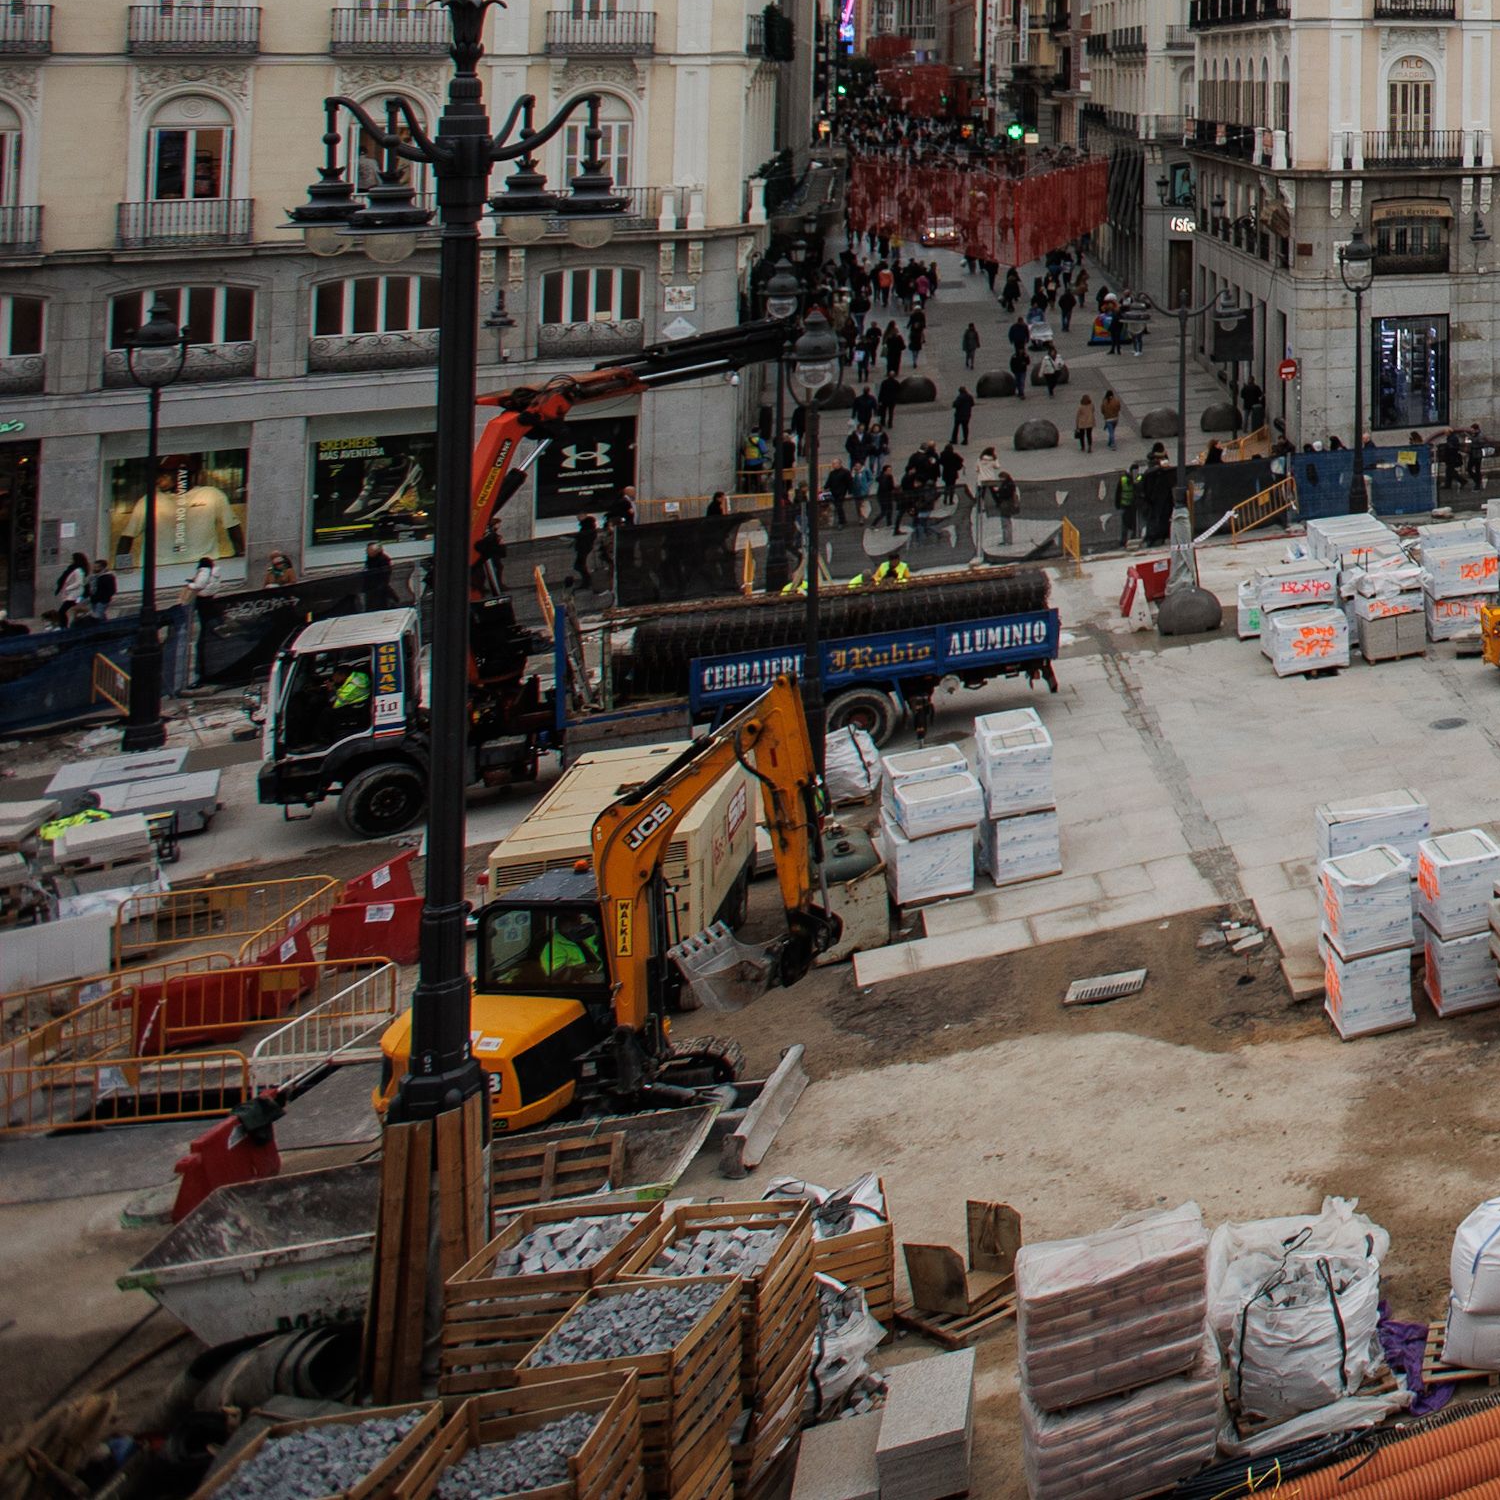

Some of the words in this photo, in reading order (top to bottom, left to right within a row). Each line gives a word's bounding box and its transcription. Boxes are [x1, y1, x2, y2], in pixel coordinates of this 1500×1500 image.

[340, 447, 385, 459] AVENTURA
[948, 621, 1047, 656] ALUMINIO
[378, 644, 396, 692] GRUAS
[628, 802, 673, 849] JCB
[619, 902, 631, 953] WALKIA
